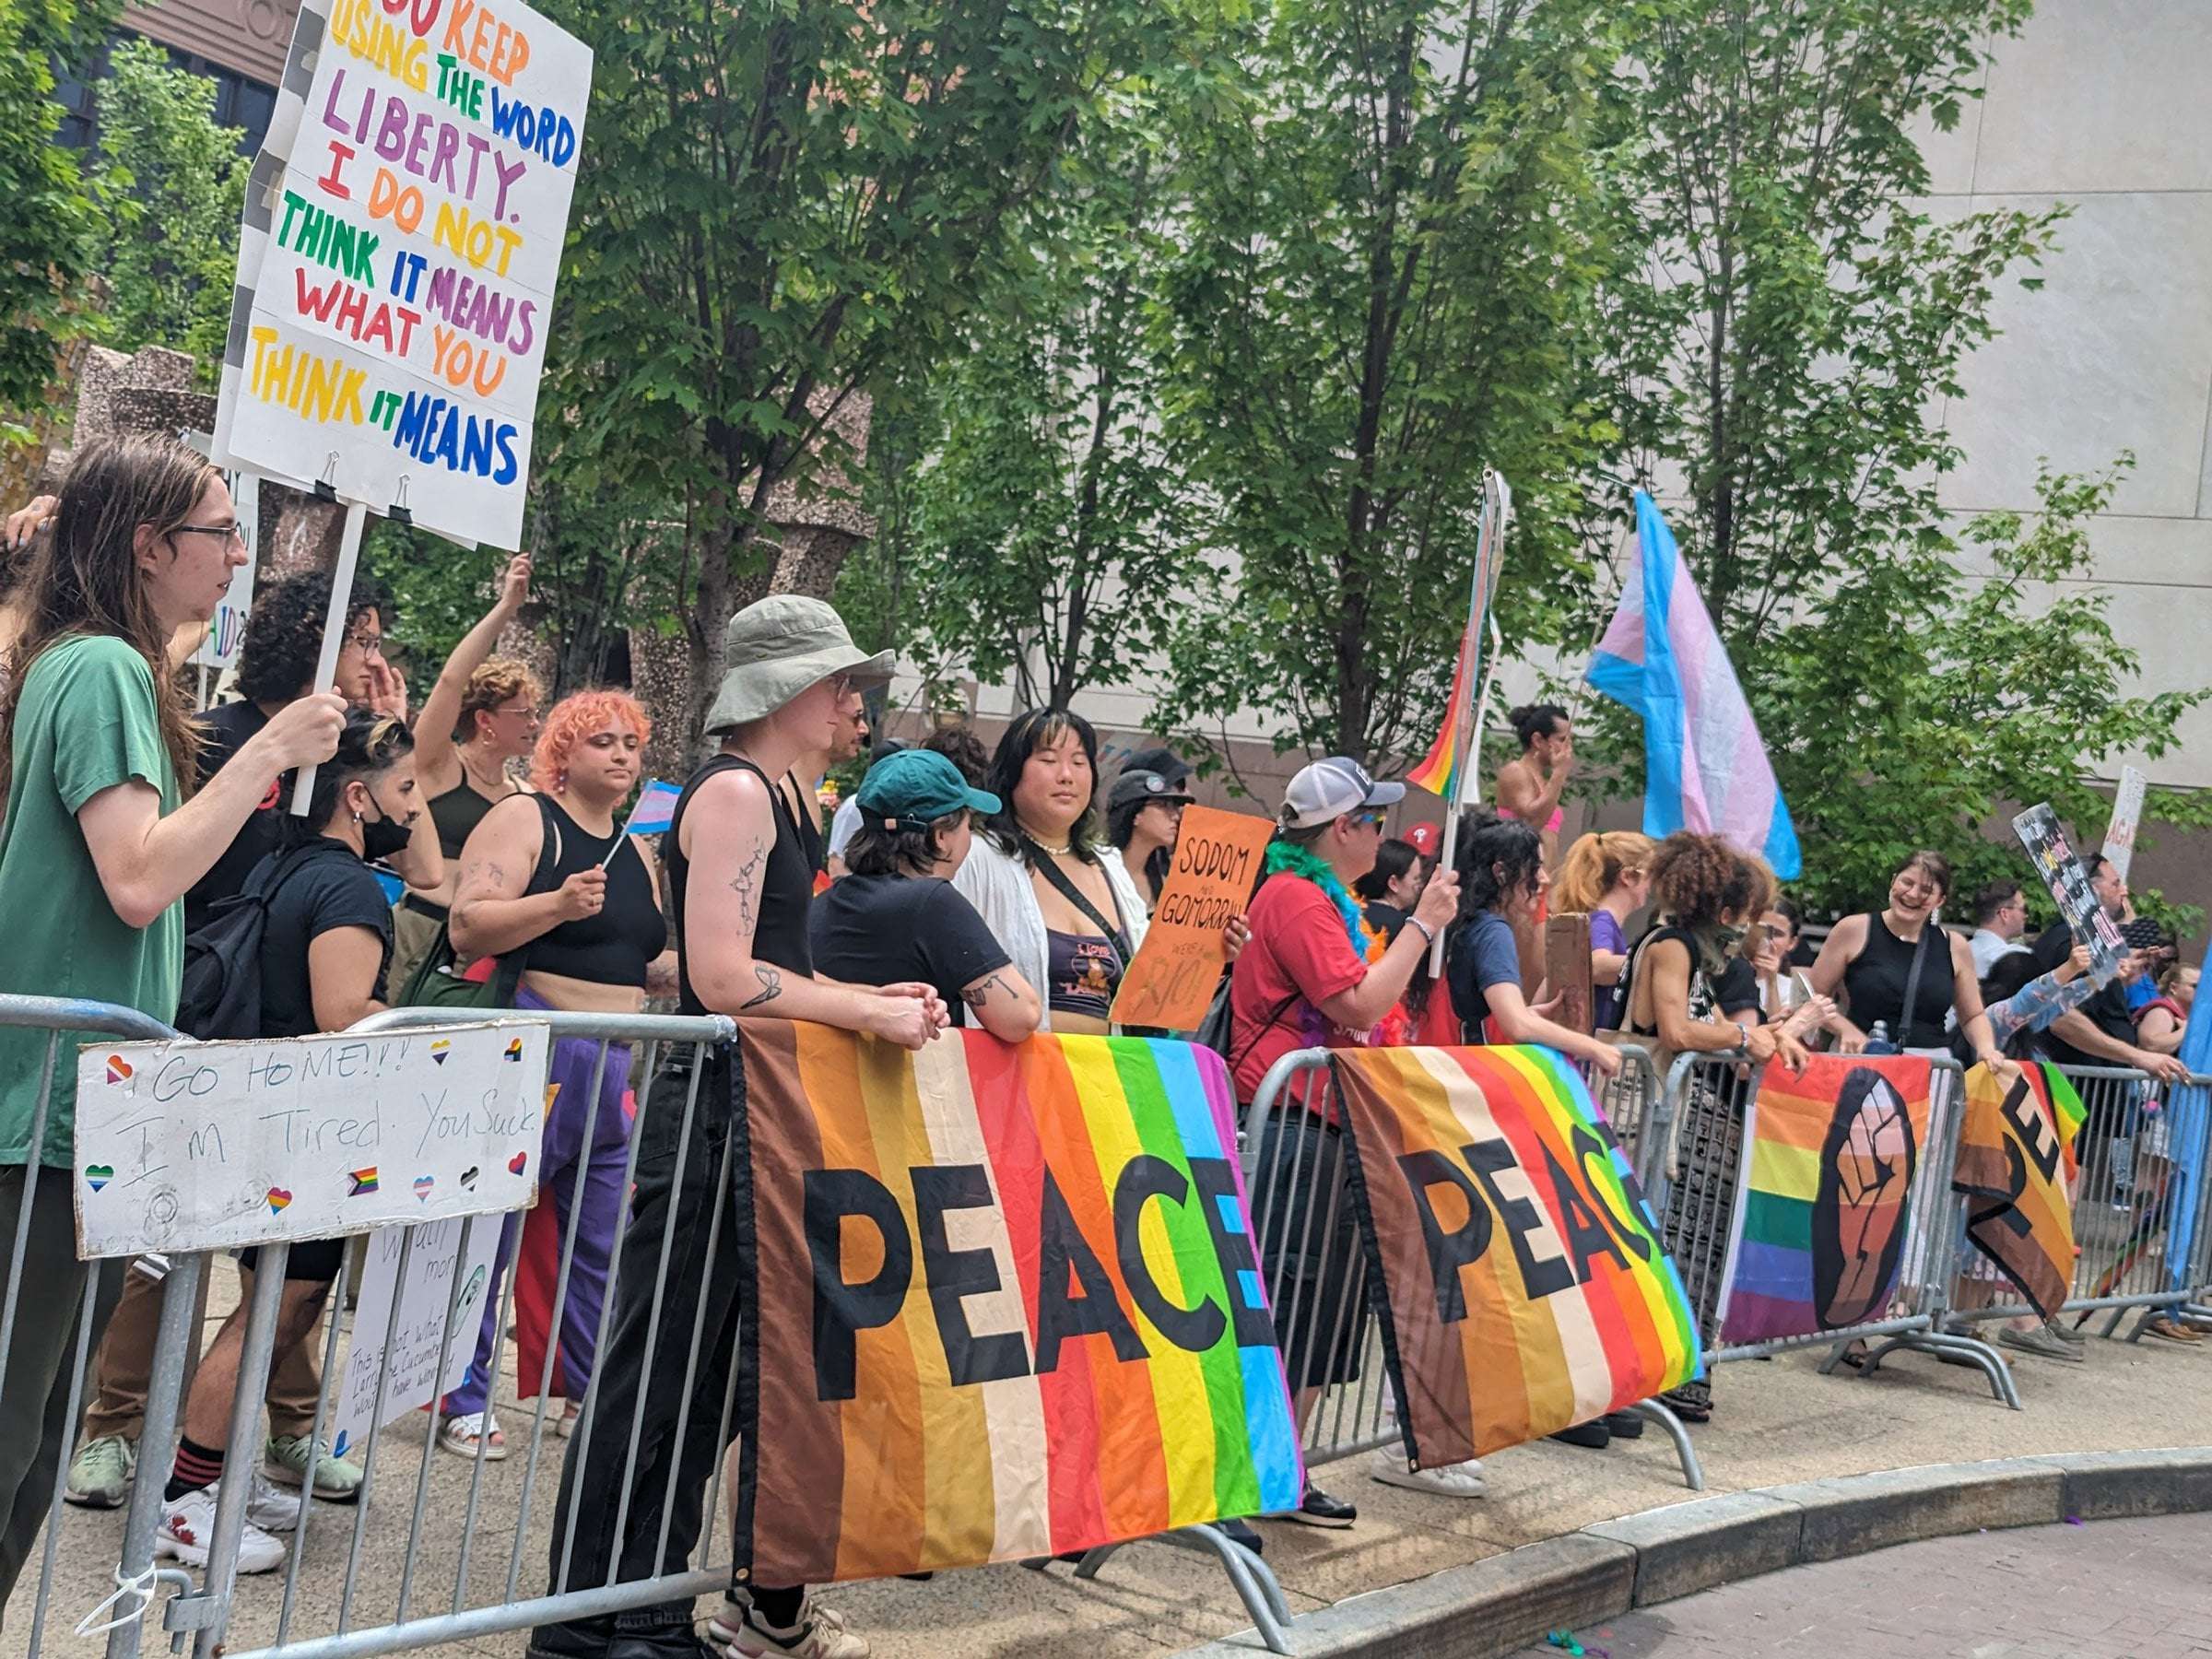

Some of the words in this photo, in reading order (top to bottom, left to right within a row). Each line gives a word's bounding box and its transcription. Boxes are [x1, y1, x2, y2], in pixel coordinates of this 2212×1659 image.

[331, 0, 428, 93] USING
[436, 53, 486, 121] THE
[490, 86, 576, 168] WORD
[442, 0, 530, 87] KEEP
[317, 140, 355, 200] I
[369, 168, 424, 235] DO
[433, 202, 523, 277] NOT
[323, 69, 526, 223] LIBERTY.
[277, 189, 381, 288] THINK
[390, 251, 427, 304] IT
[426, 265, 538, 356] MEANS
[295, 267, 422, 358] WHAT
[431, 324, 508, 396] YOU
[251, 326, 368, 426] THINK
[369, 391, 403, 432] IT
[393, 391, 519, 486] MEANS
[1179, 836, 1250, 886] SODOM
[152, 1056, 219, 1102] GO
[416, 1088, 473, 1158] You
[804, 1155, 1277, 1402] PEACE
[1397, 1122, 1670, 1324] PEACE
